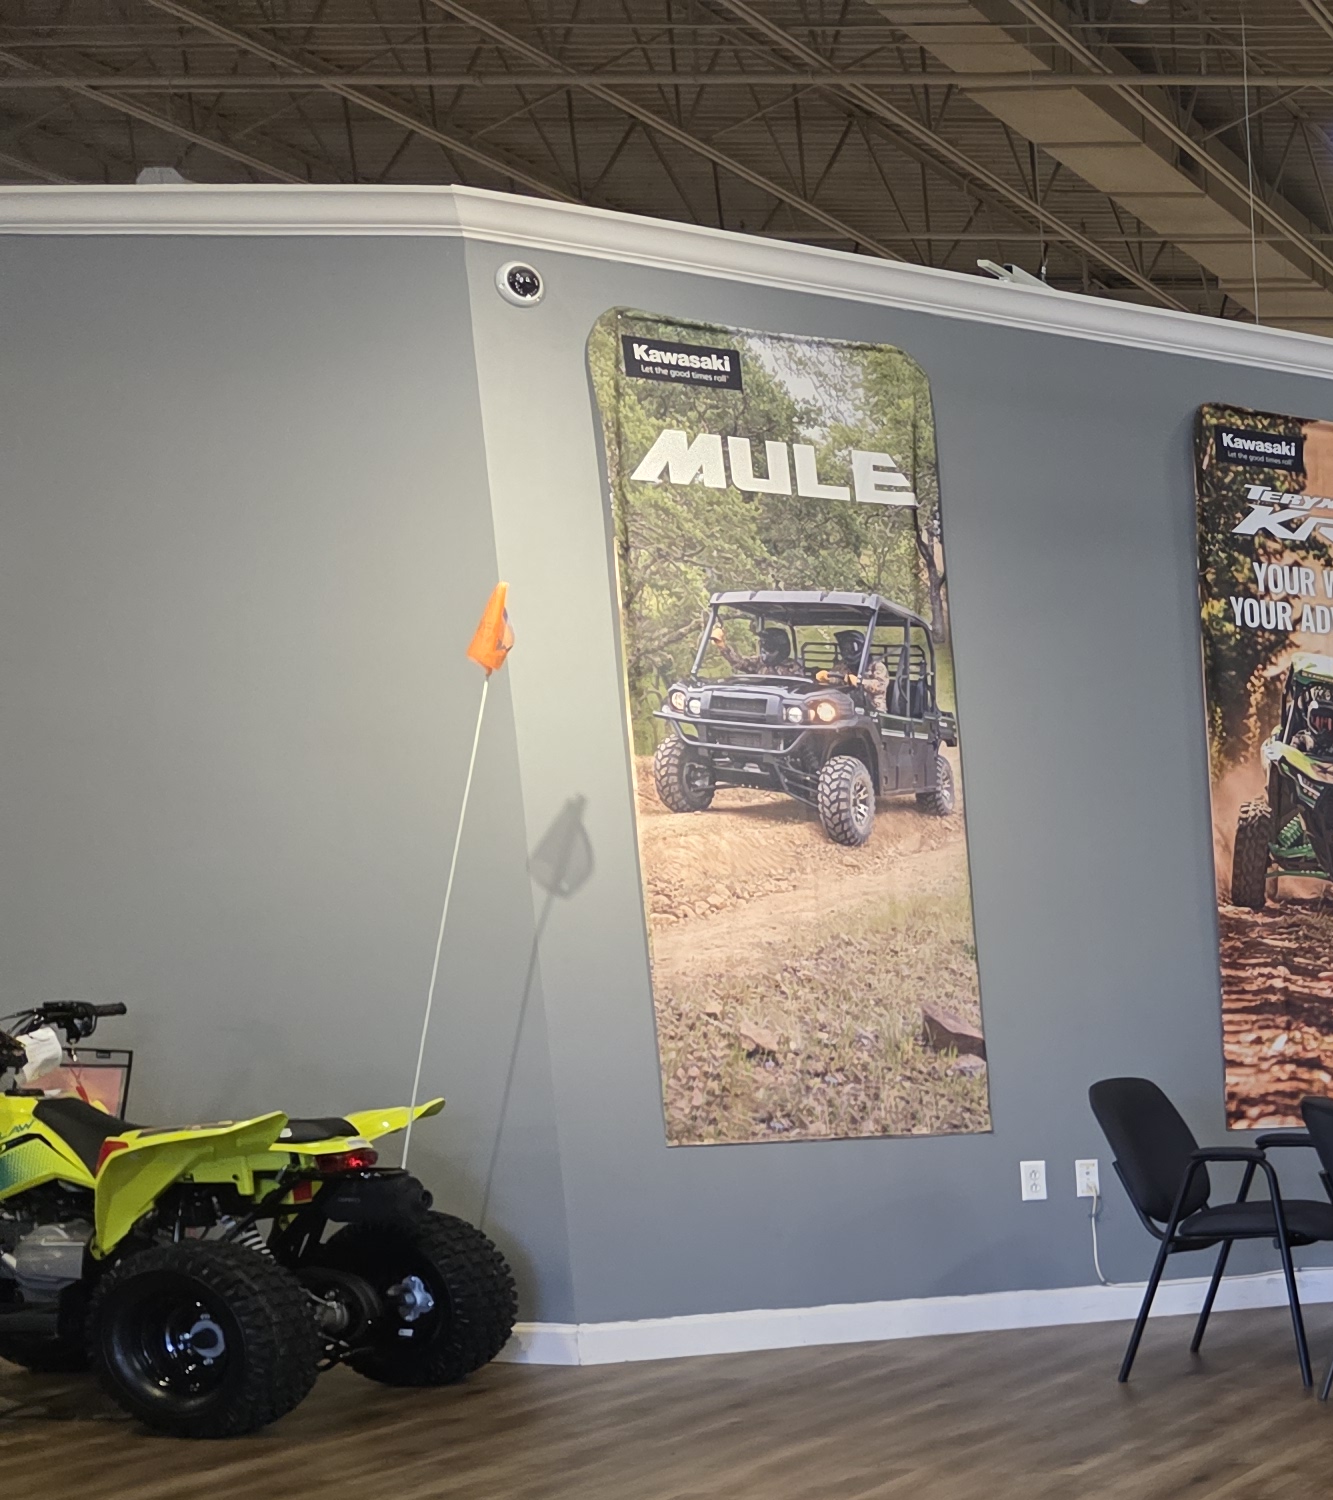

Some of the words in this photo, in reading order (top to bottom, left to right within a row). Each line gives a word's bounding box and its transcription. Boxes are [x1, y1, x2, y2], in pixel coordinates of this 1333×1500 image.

[632, 343, 731, 372] Kawasaki
[641, 365, 654, 375] Let
[656, 366, 669, 377] the
[670, 368, 690, 379] good
[691, 369, 712, 382] times
[1222, 433, 1295, 456] Kawasaki
[1238, 452, 1248, 460] the
[1249, 454, 1264, 462] good
[1265, 455, 1281, 464] times
[631, 429, 919, 506] MULE
[1253, 562, 1315, 596] YOUR
[1230, 596, 1293, 631] YOUR
